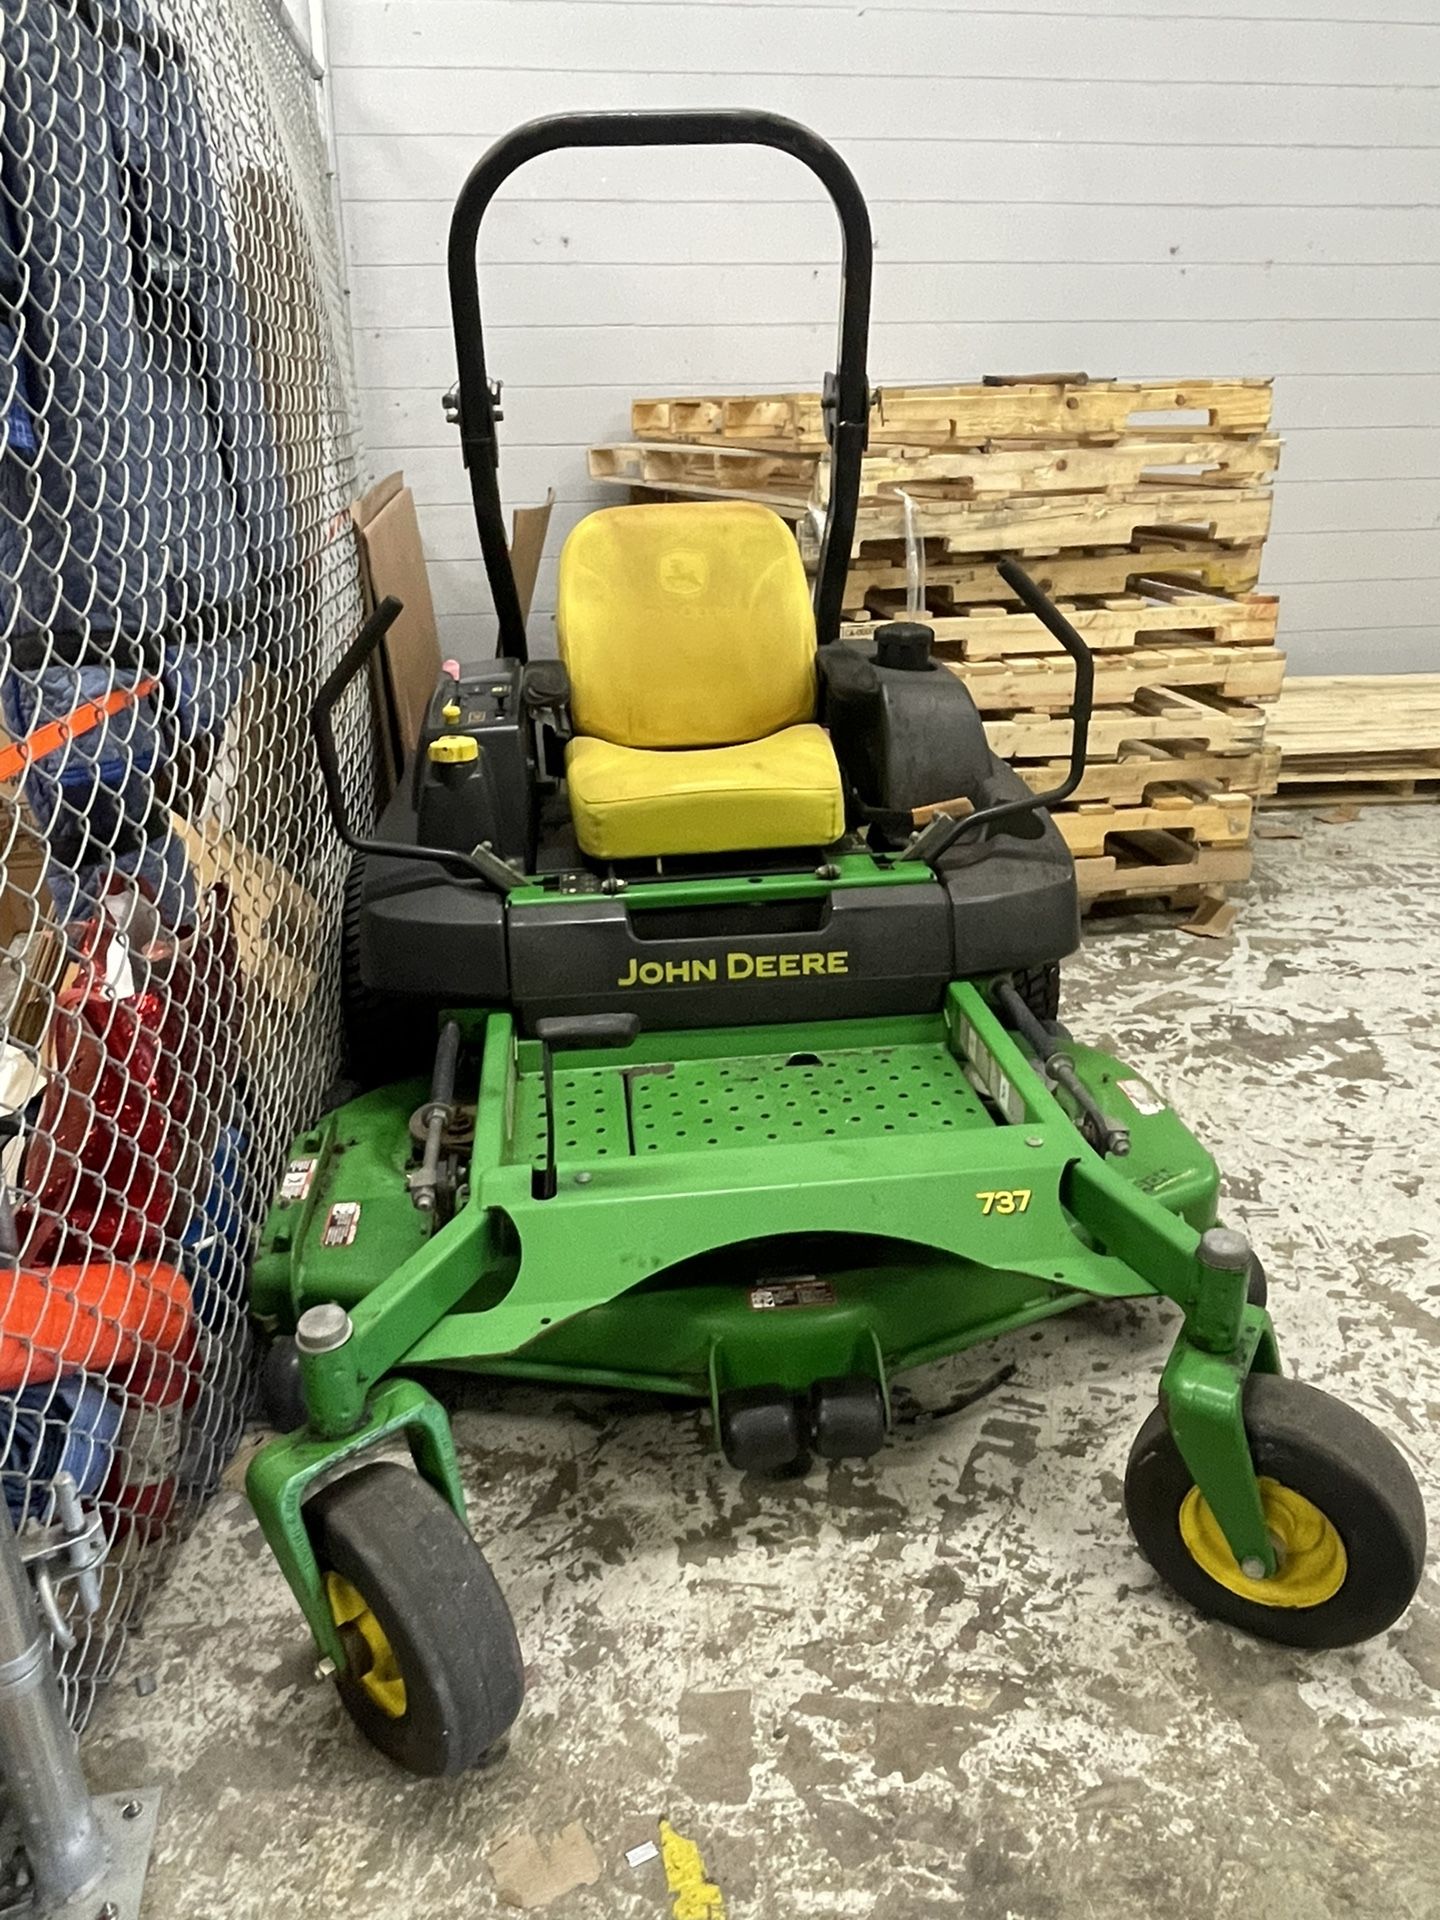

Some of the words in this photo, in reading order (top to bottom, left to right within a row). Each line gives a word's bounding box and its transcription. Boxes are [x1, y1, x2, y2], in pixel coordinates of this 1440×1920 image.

[618, 958, 717, 986] JOHN
[727, 951, 849, 980] DEERE
[976, 1189, 1032, 1215] 737
